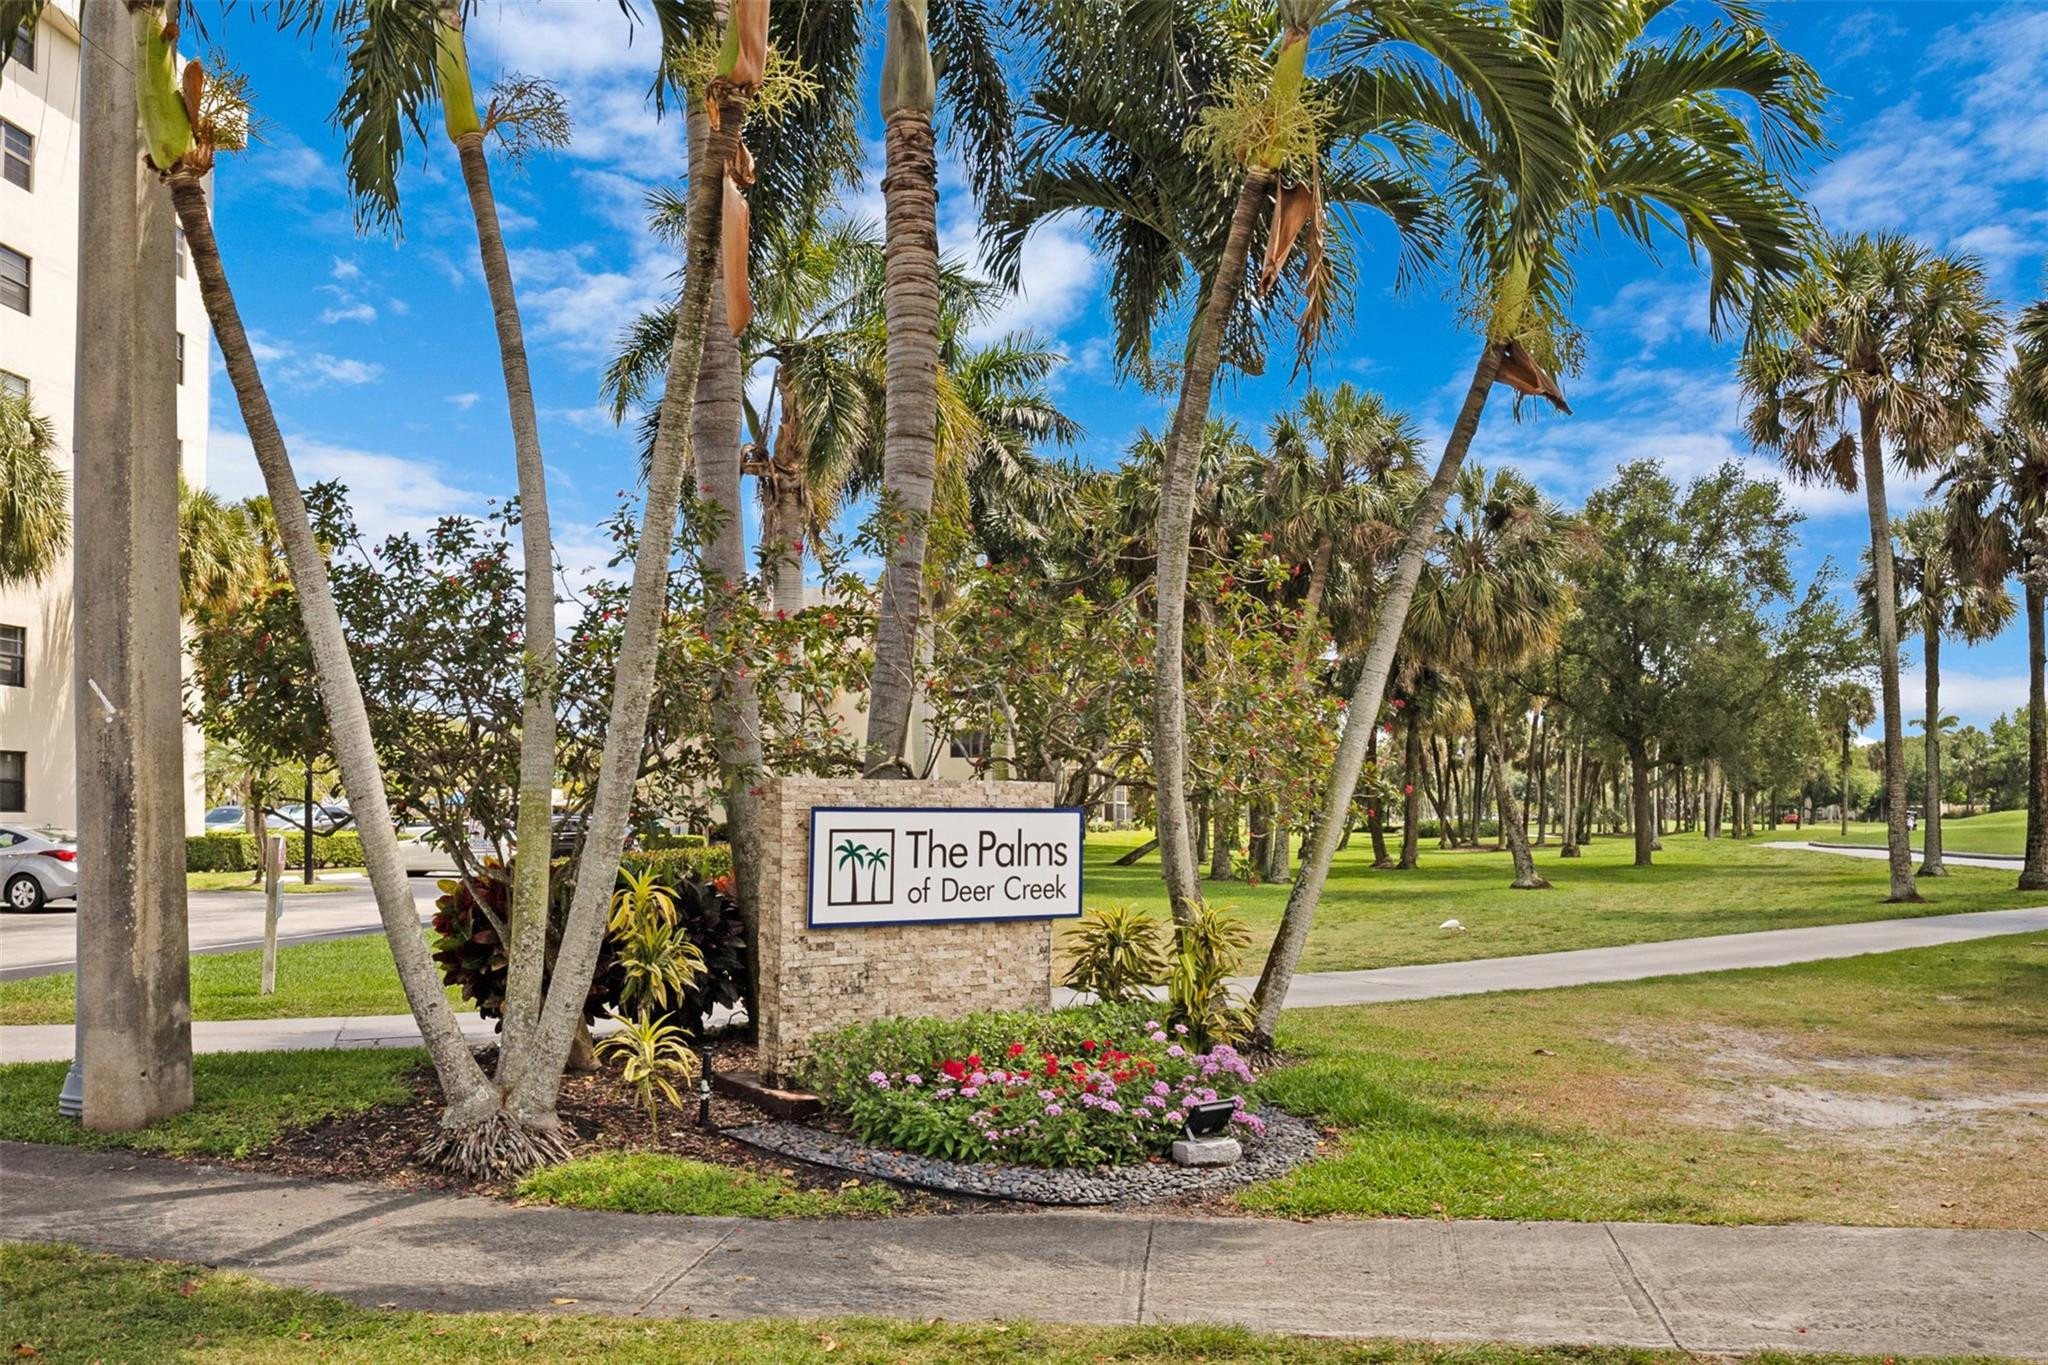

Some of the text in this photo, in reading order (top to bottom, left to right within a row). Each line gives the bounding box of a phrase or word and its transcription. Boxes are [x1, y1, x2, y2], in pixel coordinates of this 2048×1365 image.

[905, 828, 1068, 868] The Palms
[907, 873, 1067, 904] of Deer Creek
